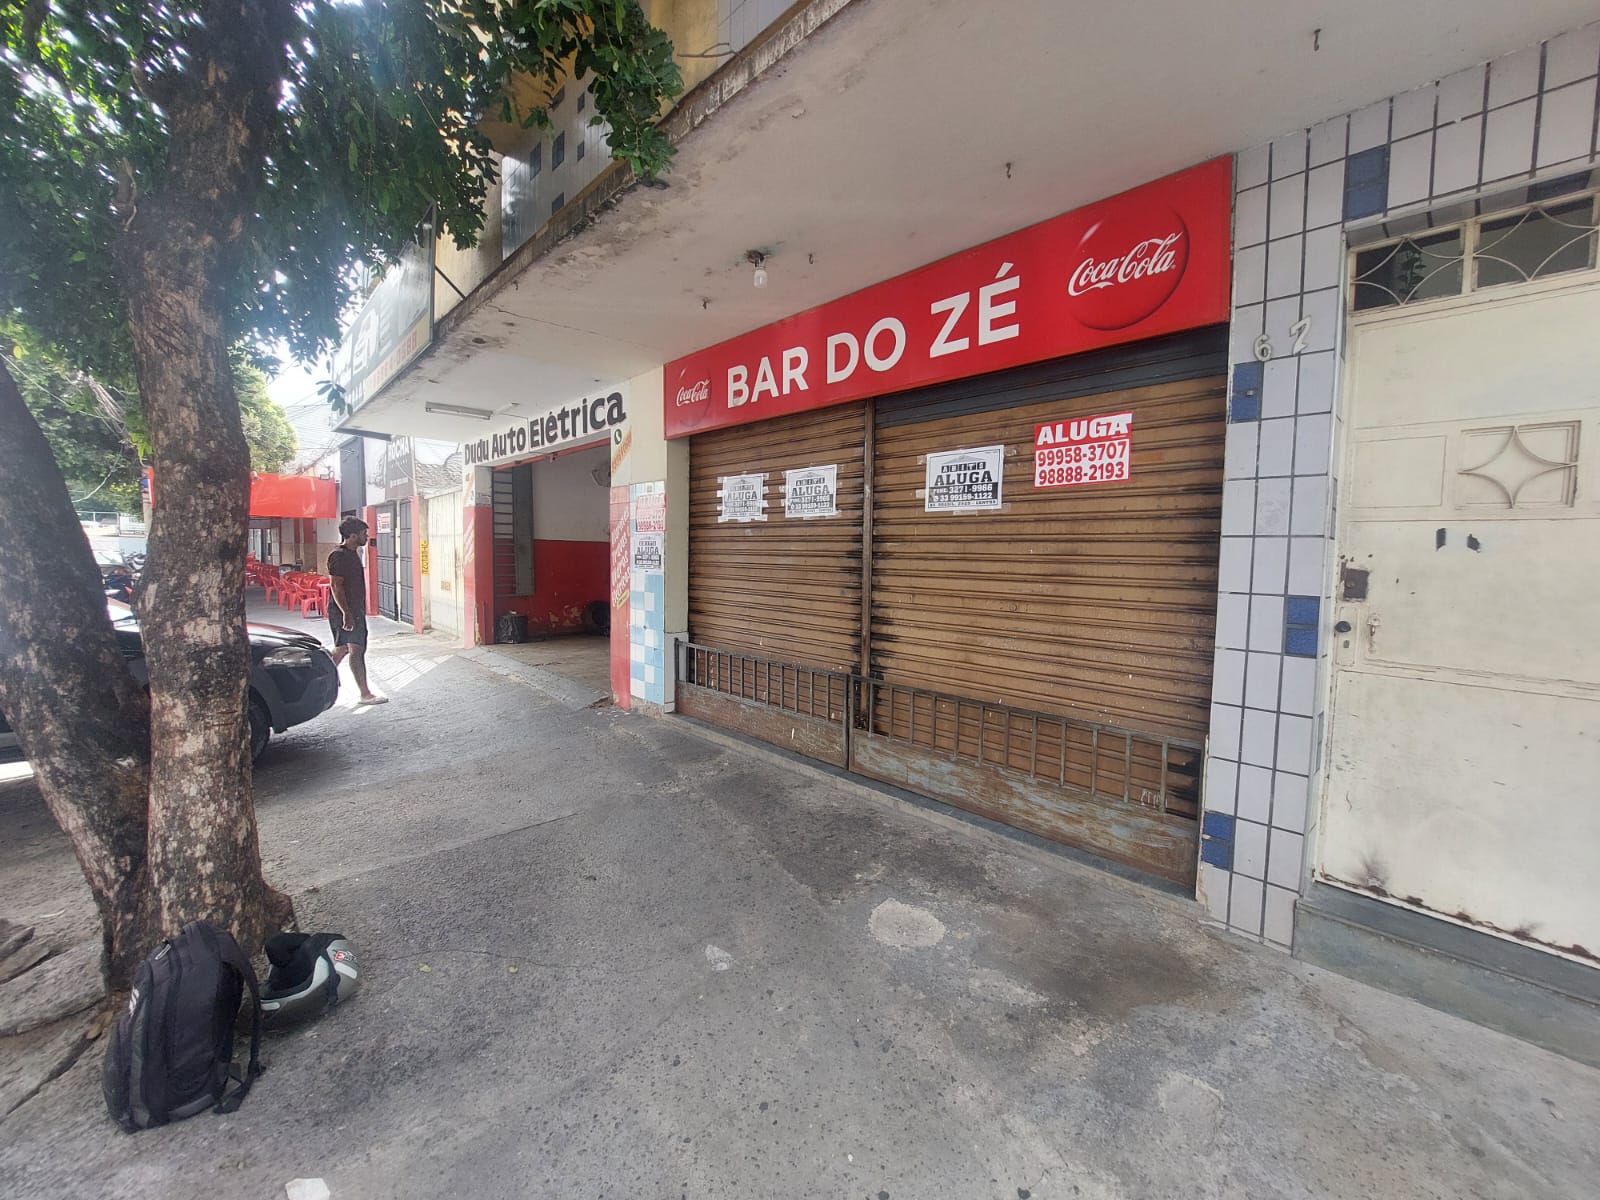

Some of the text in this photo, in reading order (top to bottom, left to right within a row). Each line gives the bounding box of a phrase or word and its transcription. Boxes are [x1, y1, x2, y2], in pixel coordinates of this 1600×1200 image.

[1067, 231, 1184, 297] Coca-Cola
[727, 262, 1021, 408] BAR DO ZÉ
[675, 378, 712, 407] Coca-Cola
[464, 391, 627, 465] Dudu Auto Elétrica
[1036, 413, 1133, 446] ALUGA
[1037, 441, 1127, 467] 99958-3707
[934, 471, 993, 486] ALUGA
[1038, 462, 1125, 485] 98888-2193
[727, 491, 758, 501] ALUGA
[792, 485, 830, 496] ALUGA
[636, 547, 659, 555] ALUGA
